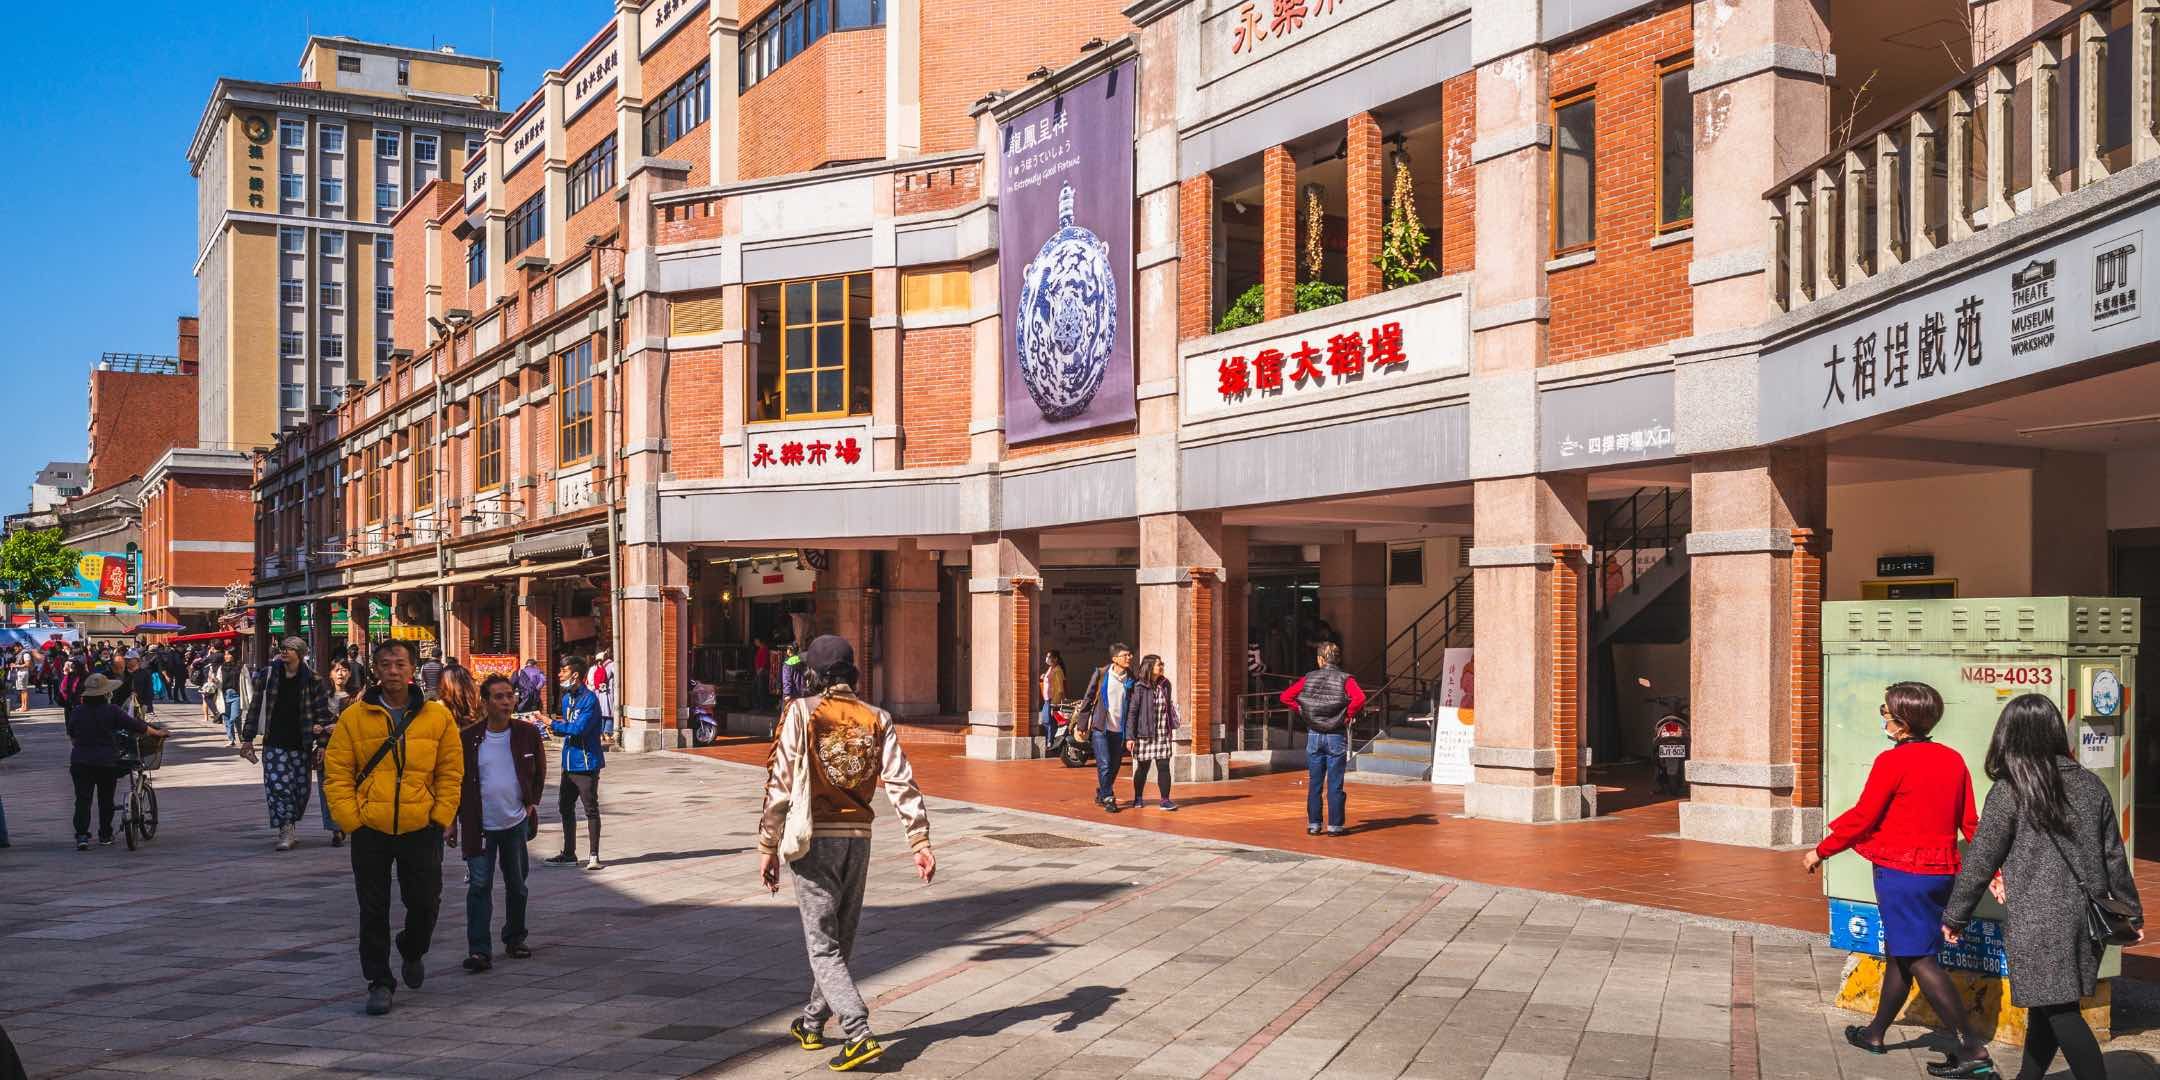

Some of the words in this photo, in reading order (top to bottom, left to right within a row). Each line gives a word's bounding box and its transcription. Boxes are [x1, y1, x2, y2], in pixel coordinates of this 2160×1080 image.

[1007, 109, 1069, 158] 龍鳳呈祥
[2011, 307, 2055, 335] MUSEUM
[1822, 295, 1985, 409] 大稻埕戲苑
[2010, 332, 2056, 357] WORKSHOP
[751, 437, 862, 469] 永樂市場
[1961, 667, 2053, 684] N4B-4033
